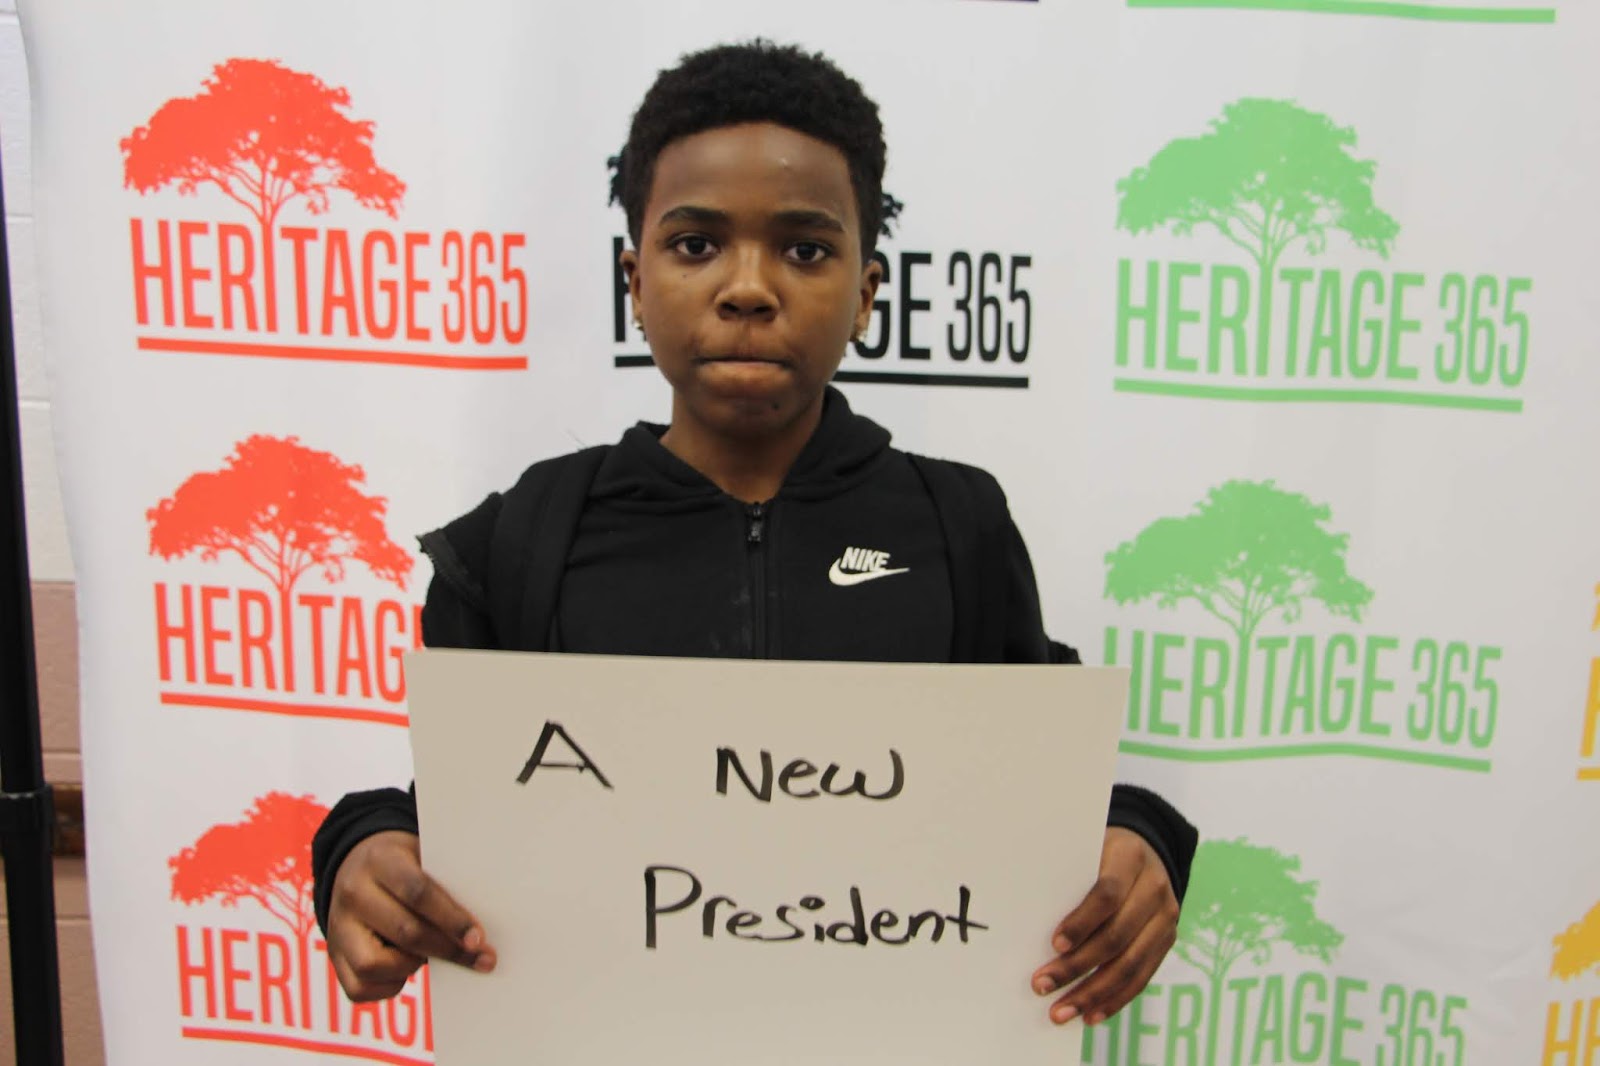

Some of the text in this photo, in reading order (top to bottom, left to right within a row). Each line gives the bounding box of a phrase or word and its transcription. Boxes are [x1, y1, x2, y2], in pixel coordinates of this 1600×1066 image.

[130, 218, 431, 341] HERITAGE
[442, 231, 528, 344] 365
[946, 251, 1032, 363] 365
[1115, 258, 1532, 388] HERITAGE 365
[840, 546, 891, 572] NIKE
[154, 583, 426, 703] HERITAG
[1406, 637, 1503, 748] 365
[516, 721, 905, 803] A New
[644, 865, 989, 950] President
[1374, 983, 1469, 1066] 365
